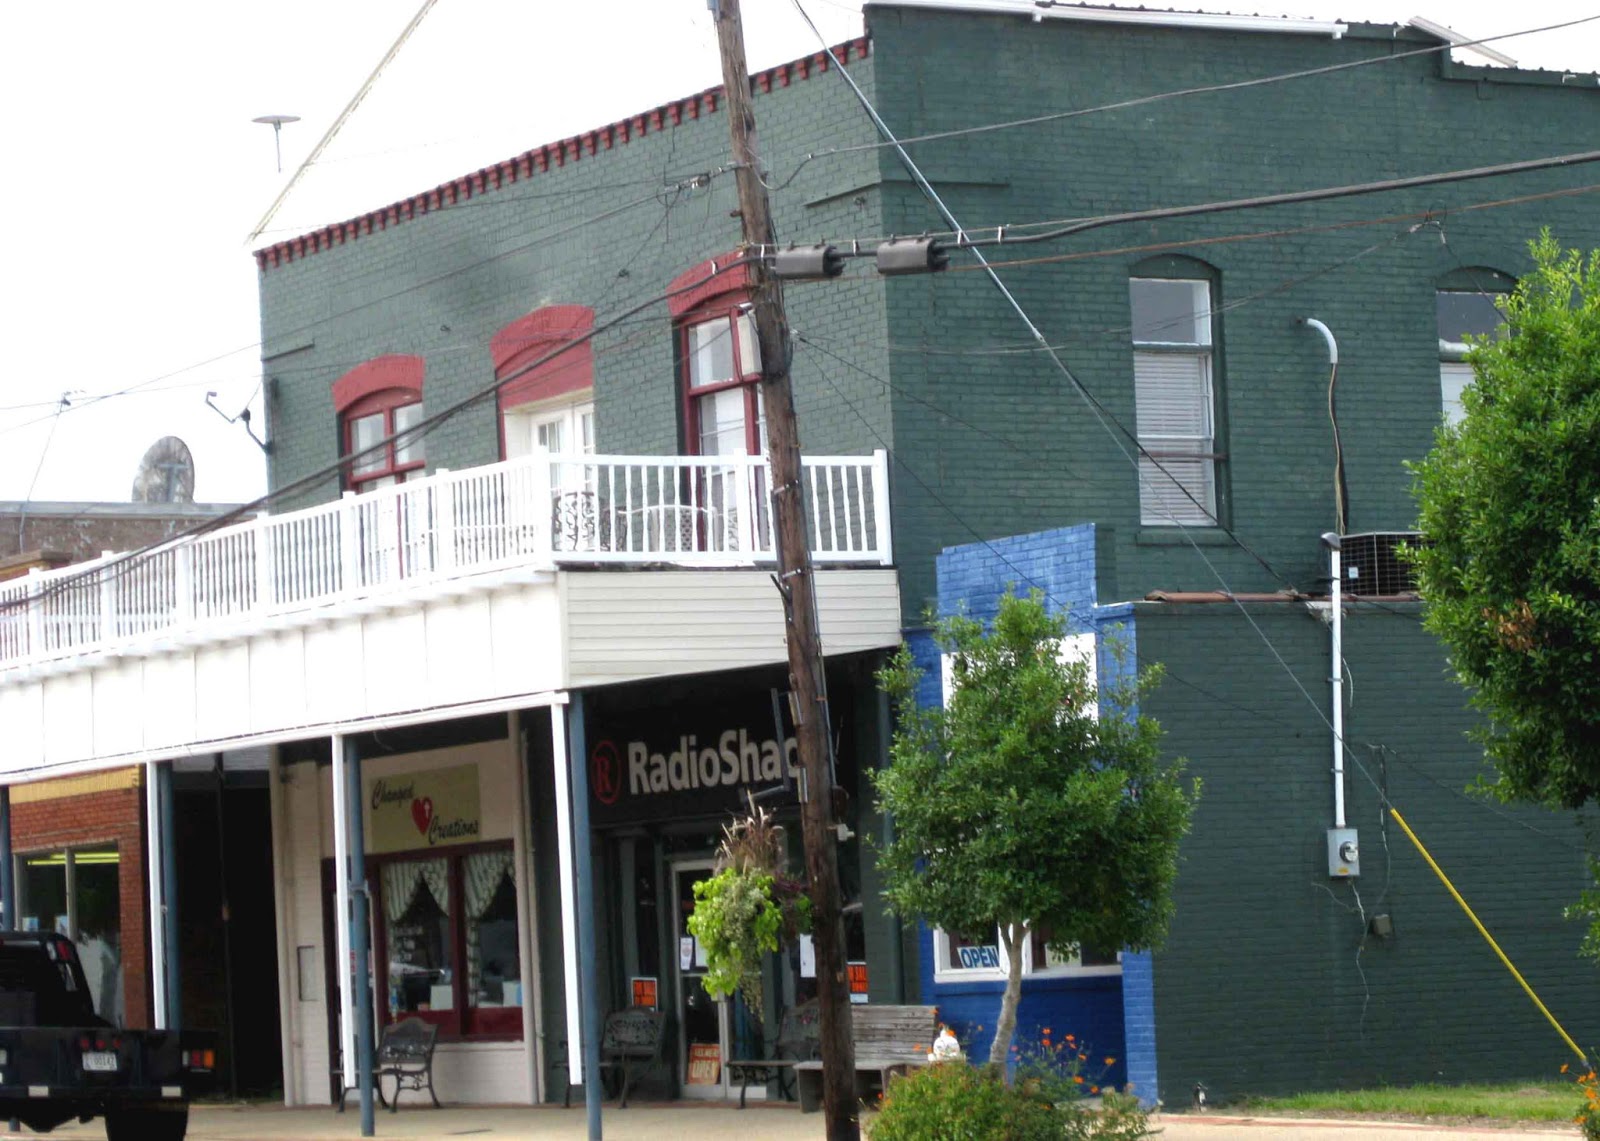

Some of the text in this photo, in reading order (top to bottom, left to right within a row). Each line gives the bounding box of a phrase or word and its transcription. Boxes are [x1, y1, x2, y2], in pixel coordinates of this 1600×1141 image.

[627, 728, 800, 796] RadioShac
[428, 815, 479, 845] Creations
[960, 947, 999, 969] OPEN
